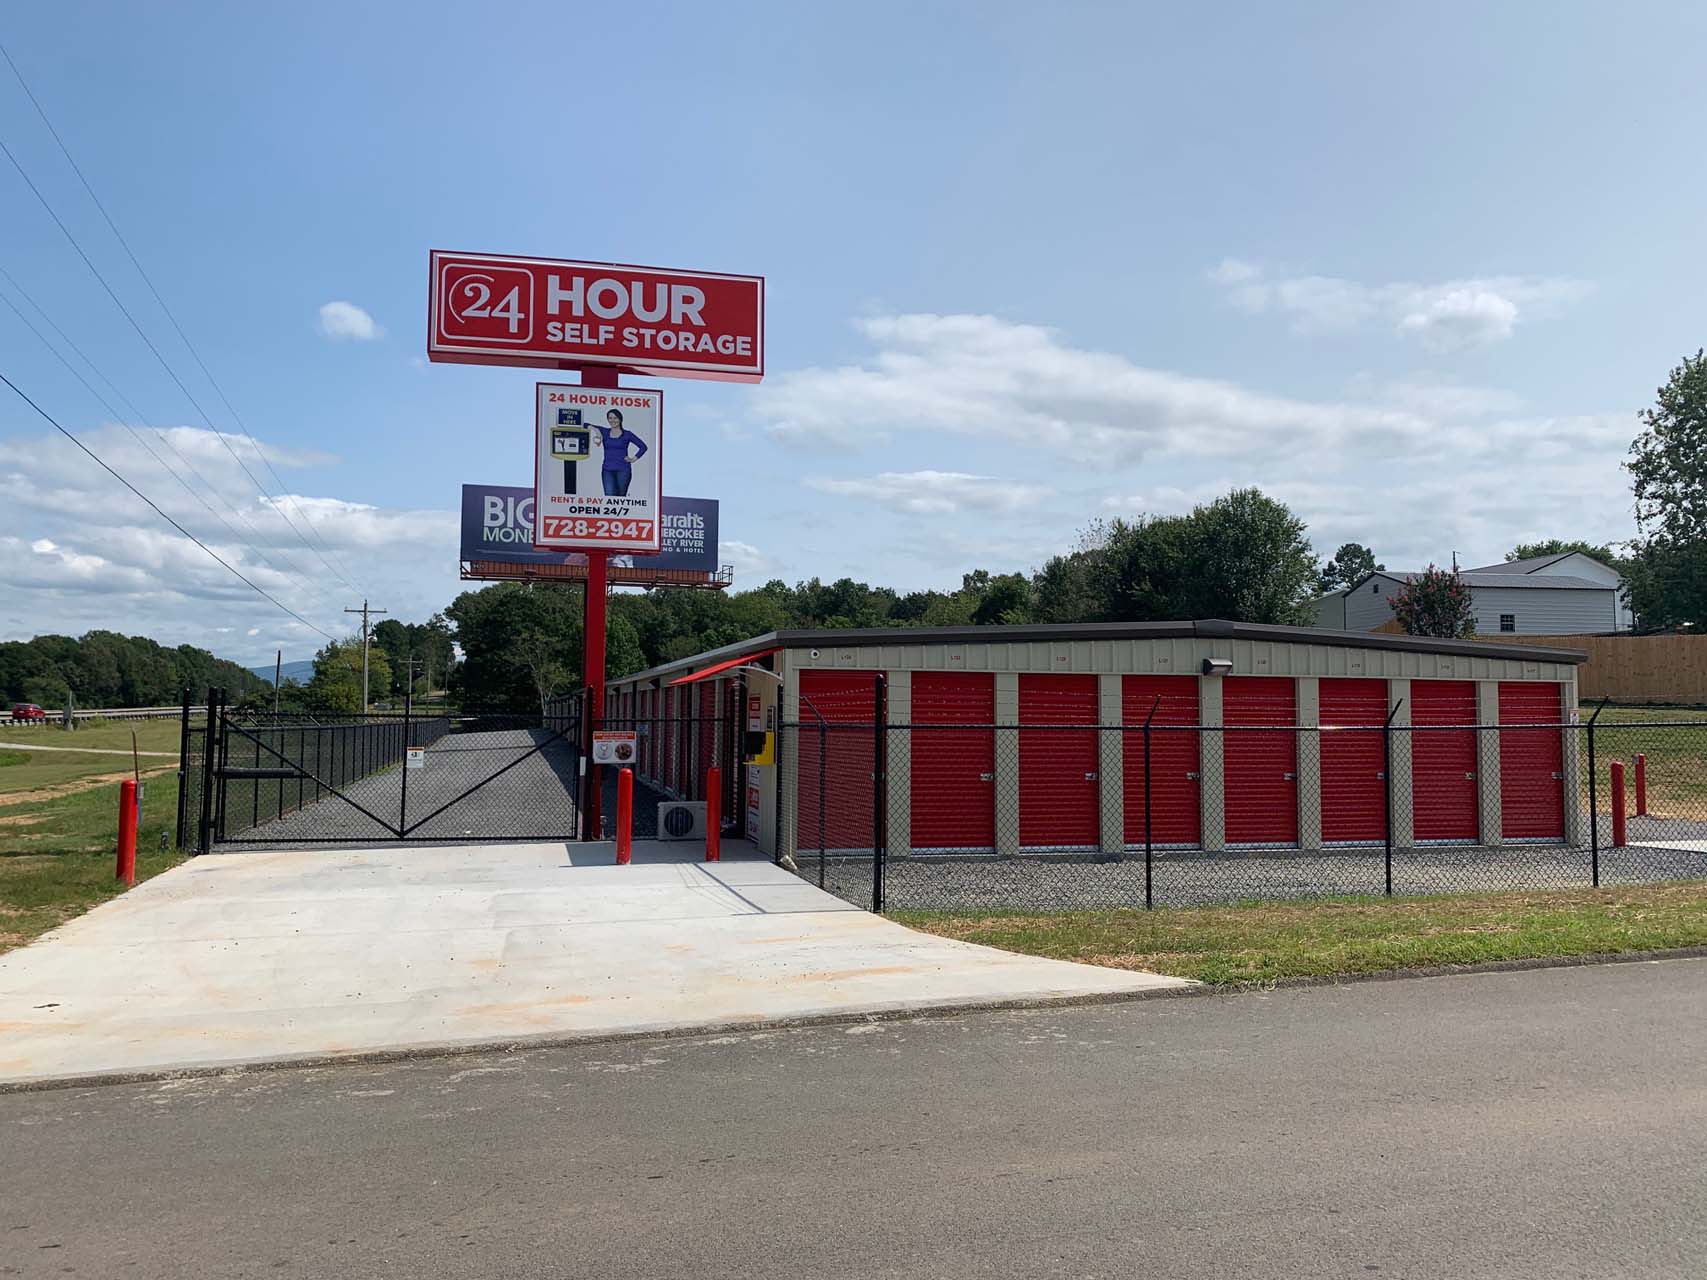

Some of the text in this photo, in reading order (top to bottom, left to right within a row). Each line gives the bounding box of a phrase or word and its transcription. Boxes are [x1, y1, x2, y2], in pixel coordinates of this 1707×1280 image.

[461, 274, 707, 334] 24 HOUR
[546, 322, 752, 356] SELF STORAGE
[549, 393, 651, 408] 24 HOUR KIOSK
[551, 496, 575, 504] RENT
[587, 497, 603, 505] PAY
[606, 498, 647, 507] ANYTIME
[484, 496, 534, 529] BIG
[569, 506, 630, 516] OPEN 24/7
[545, 519, 652, 538] 728-2947
[662, 529, 704, 539] EROKEE
